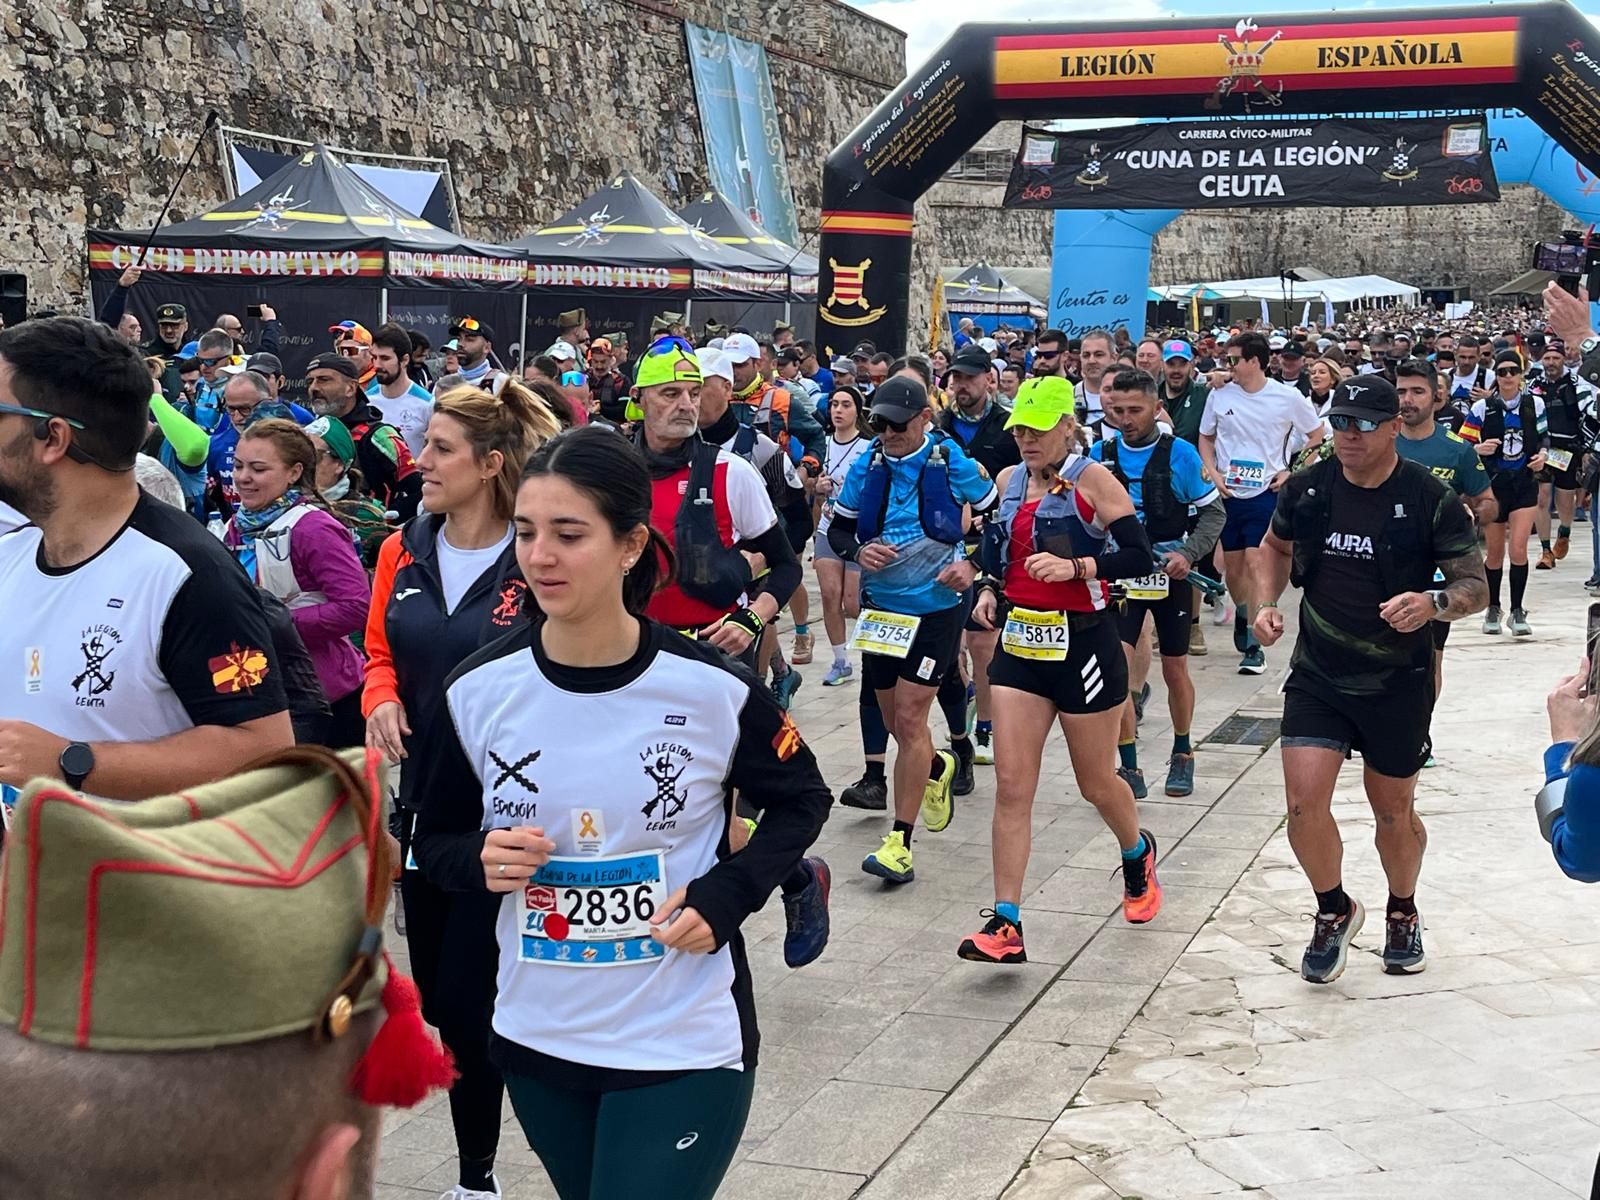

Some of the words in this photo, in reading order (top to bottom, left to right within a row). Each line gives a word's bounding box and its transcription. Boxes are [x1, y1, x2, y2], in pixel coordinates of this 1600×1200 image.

[1060, 49, 1156, 78] LEGIÓN
[1317, 40, 1463, 69] ESPAÑOLA
[890, 100, 906, 121] del
[1179, 129, 1227, 140] CARRERA
[1230, 126, 1313, 139] CÍVICO-MILITAR
[1201, 150, 1230, 168] DE
[1237, 149, 1267, 167] LA
[1199, 174, 1285, 198] CEUTA
[111, 245, 185, 273] CLUB
[192, 248, 360, 276] DEPORTIVO
[388, 250, 433, 276] TERCIO
[534, 264, 670, 289] DEPORTIVO
[1056, 287, 1109, 310] Ceuta
[1112, 294, 1130, 305] es
[1239, 466, 1262, 479] 2723
[1134, 574, 1167, 587] 4315
[878, 626, 911, 643] 5754
[1025, 626, 1065, 643] 5812
[564, 885, 655, 926] 2836
